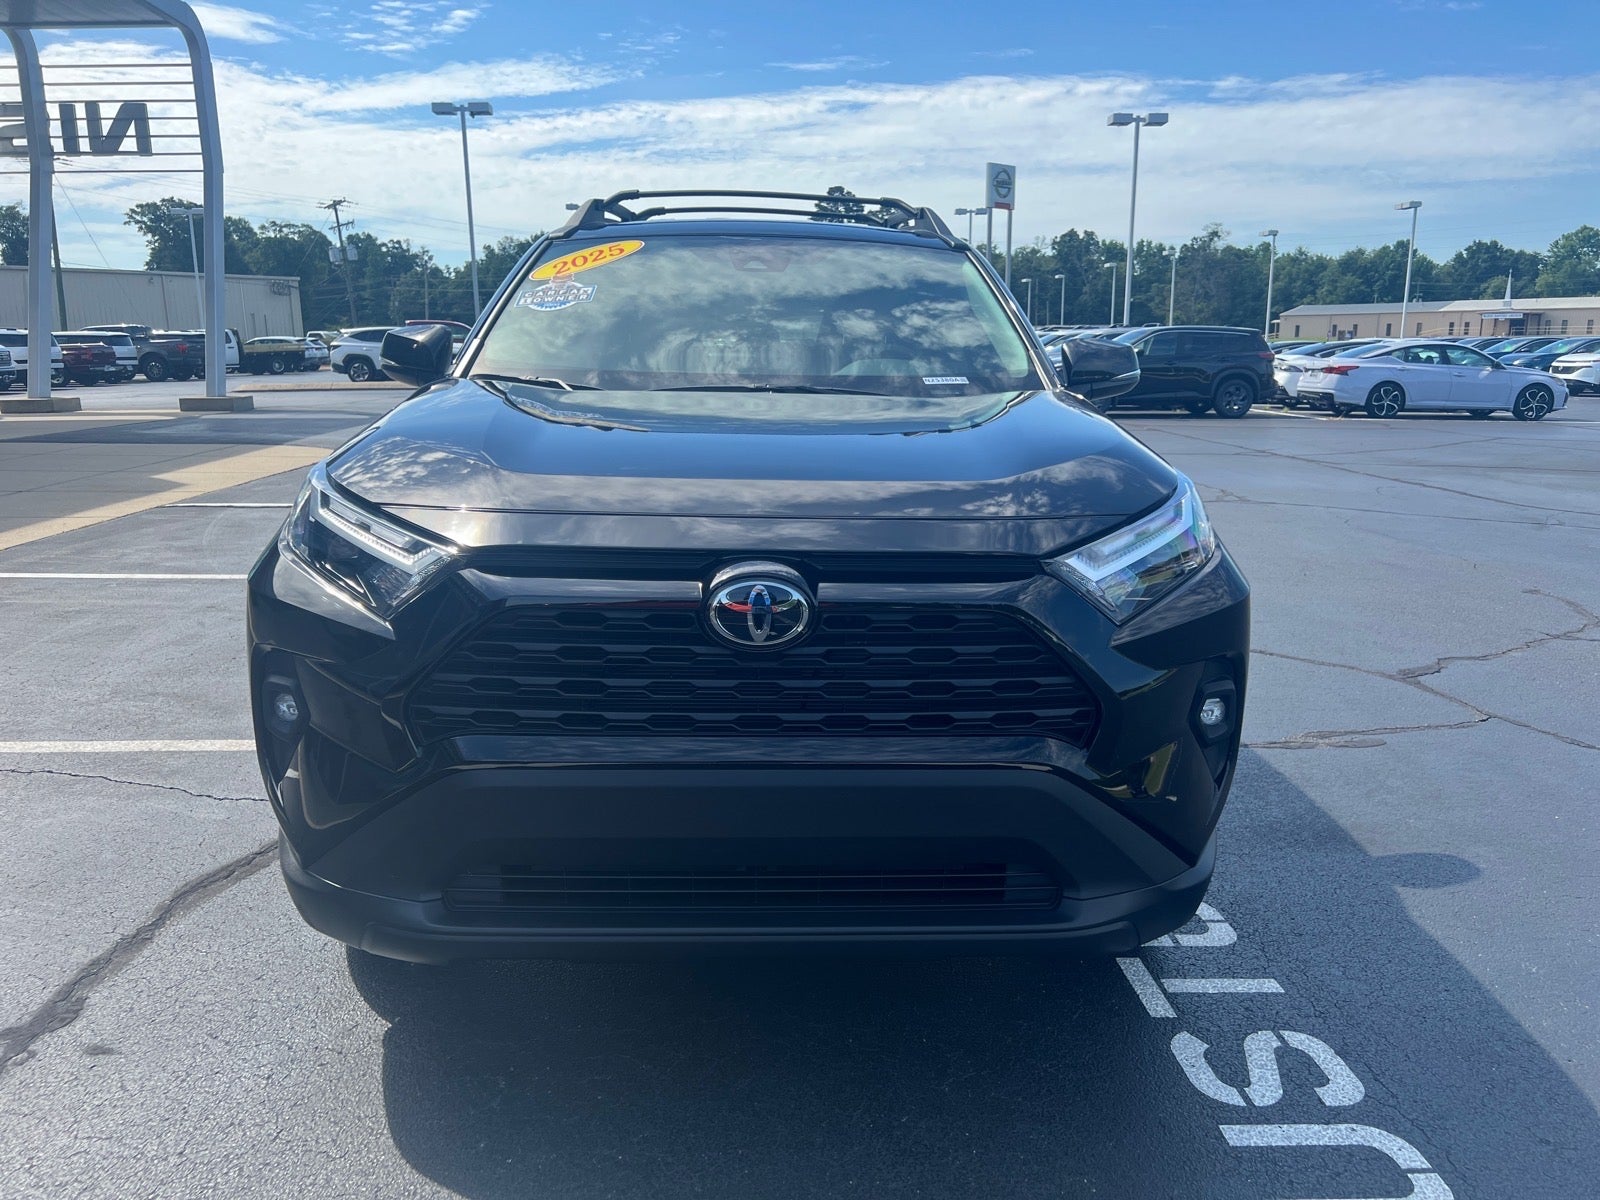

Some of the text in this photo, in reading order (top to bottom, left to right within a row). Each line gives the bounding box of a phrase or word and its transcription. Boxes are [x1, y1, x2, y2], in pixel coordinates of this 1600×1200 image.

[553, 243, 625, 275] 2025
[524, 287, 591, 298] CARFAX
[533, 294, 588, 303] OWNER
